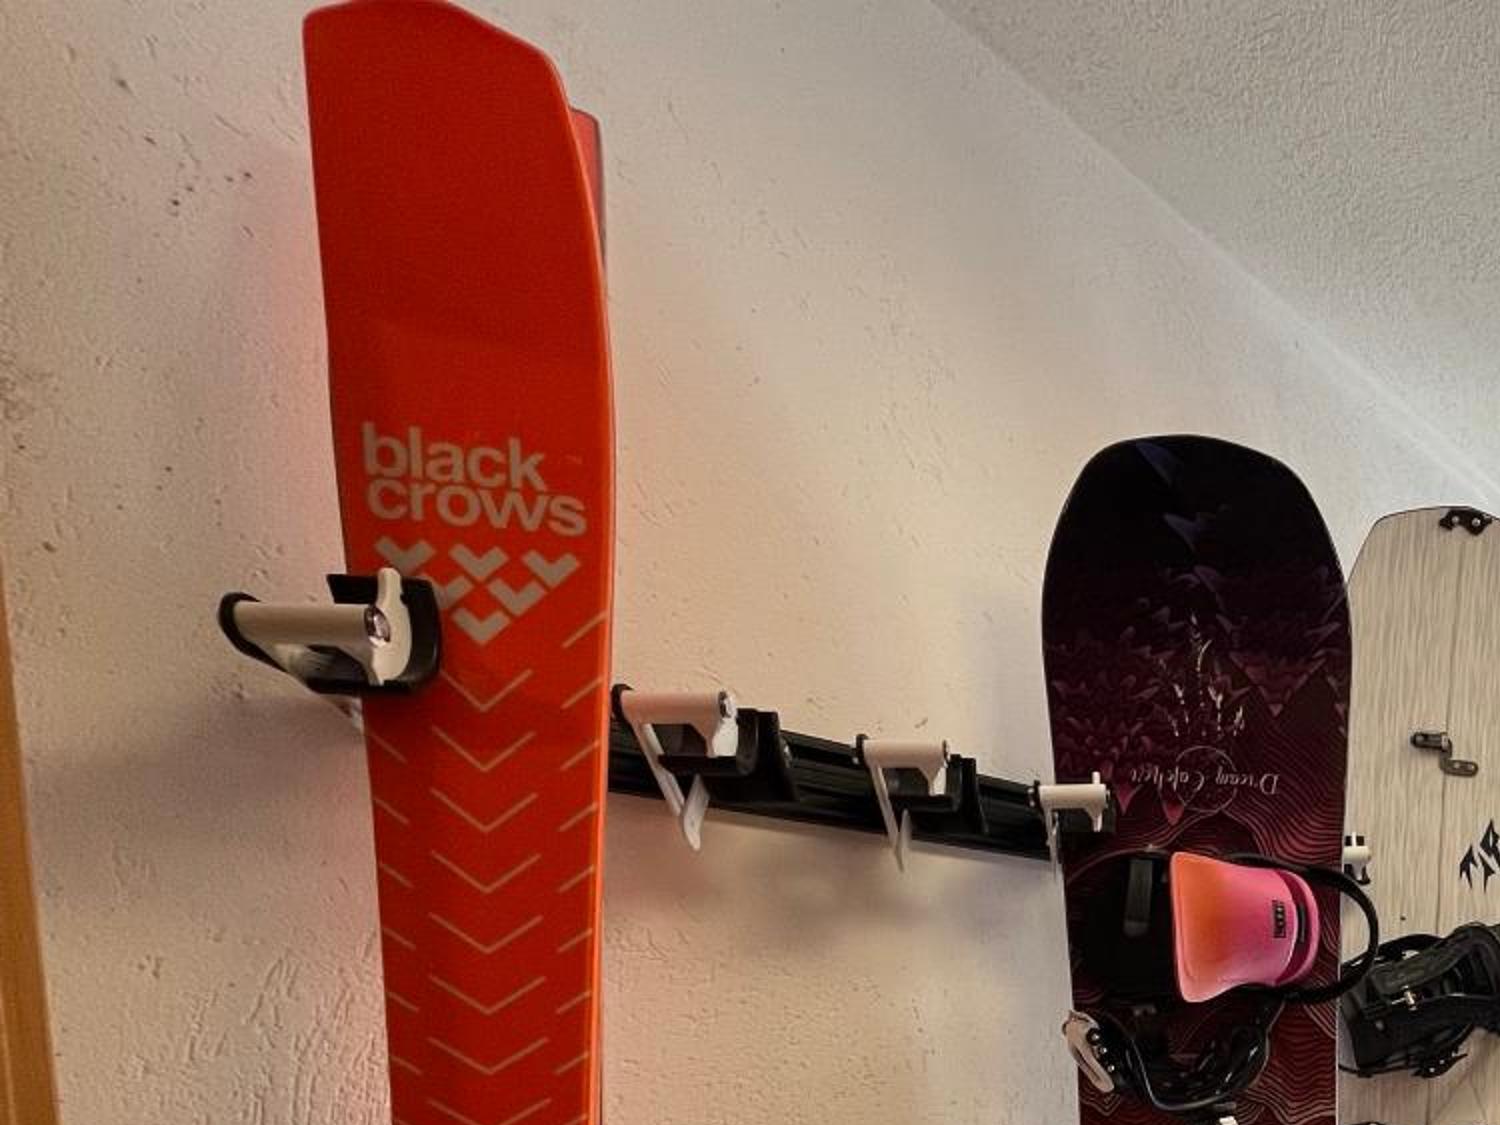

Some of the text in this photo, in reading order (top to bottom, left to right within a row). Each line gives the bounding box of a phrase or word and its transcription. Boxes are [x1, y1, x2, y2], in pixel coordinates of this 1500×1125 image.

[361, 421, 547, 492] black
[367, 478, 588, 537] crows
[1215, 765, 1280, 795] Dream
